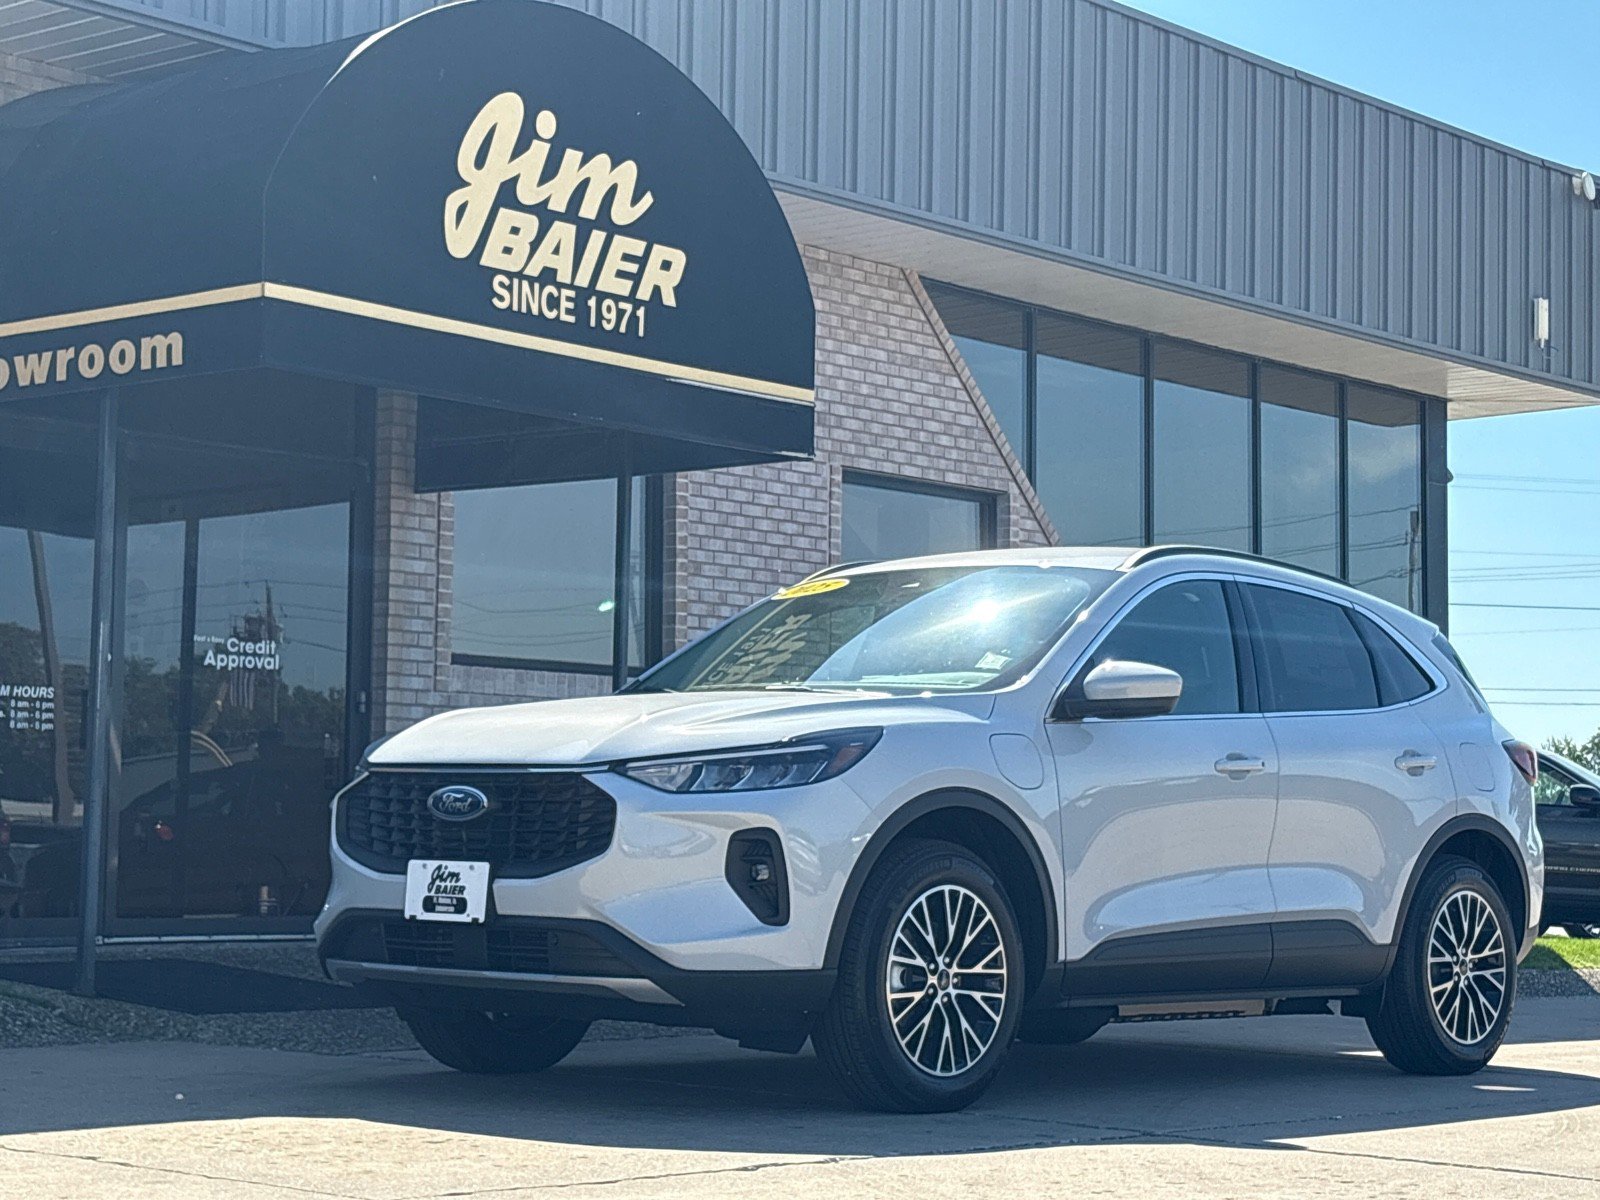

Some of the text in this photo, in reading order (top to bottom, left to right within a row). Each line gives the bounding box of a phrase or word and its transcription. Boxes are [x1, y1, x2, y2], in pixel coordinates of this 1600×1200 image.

[444, 91, 654, 258] Jim
[479, 207, 687, 308] BAIER
[491, 274, 645, 338] SINCE 1971
[226, 637, 277, 655] Credit
[203, 649, 280, 671] Approval
[13, 685, 55, 698] HOURS
[41, 701, 54, 710] pm
[41, 711, 54, 720] pm
[41, 722, 54, 731] pm
[439, 792, 472, 813] Ford
[427, 864, 462, 894] Jim
[434, 884, 466, 896] BAIER
